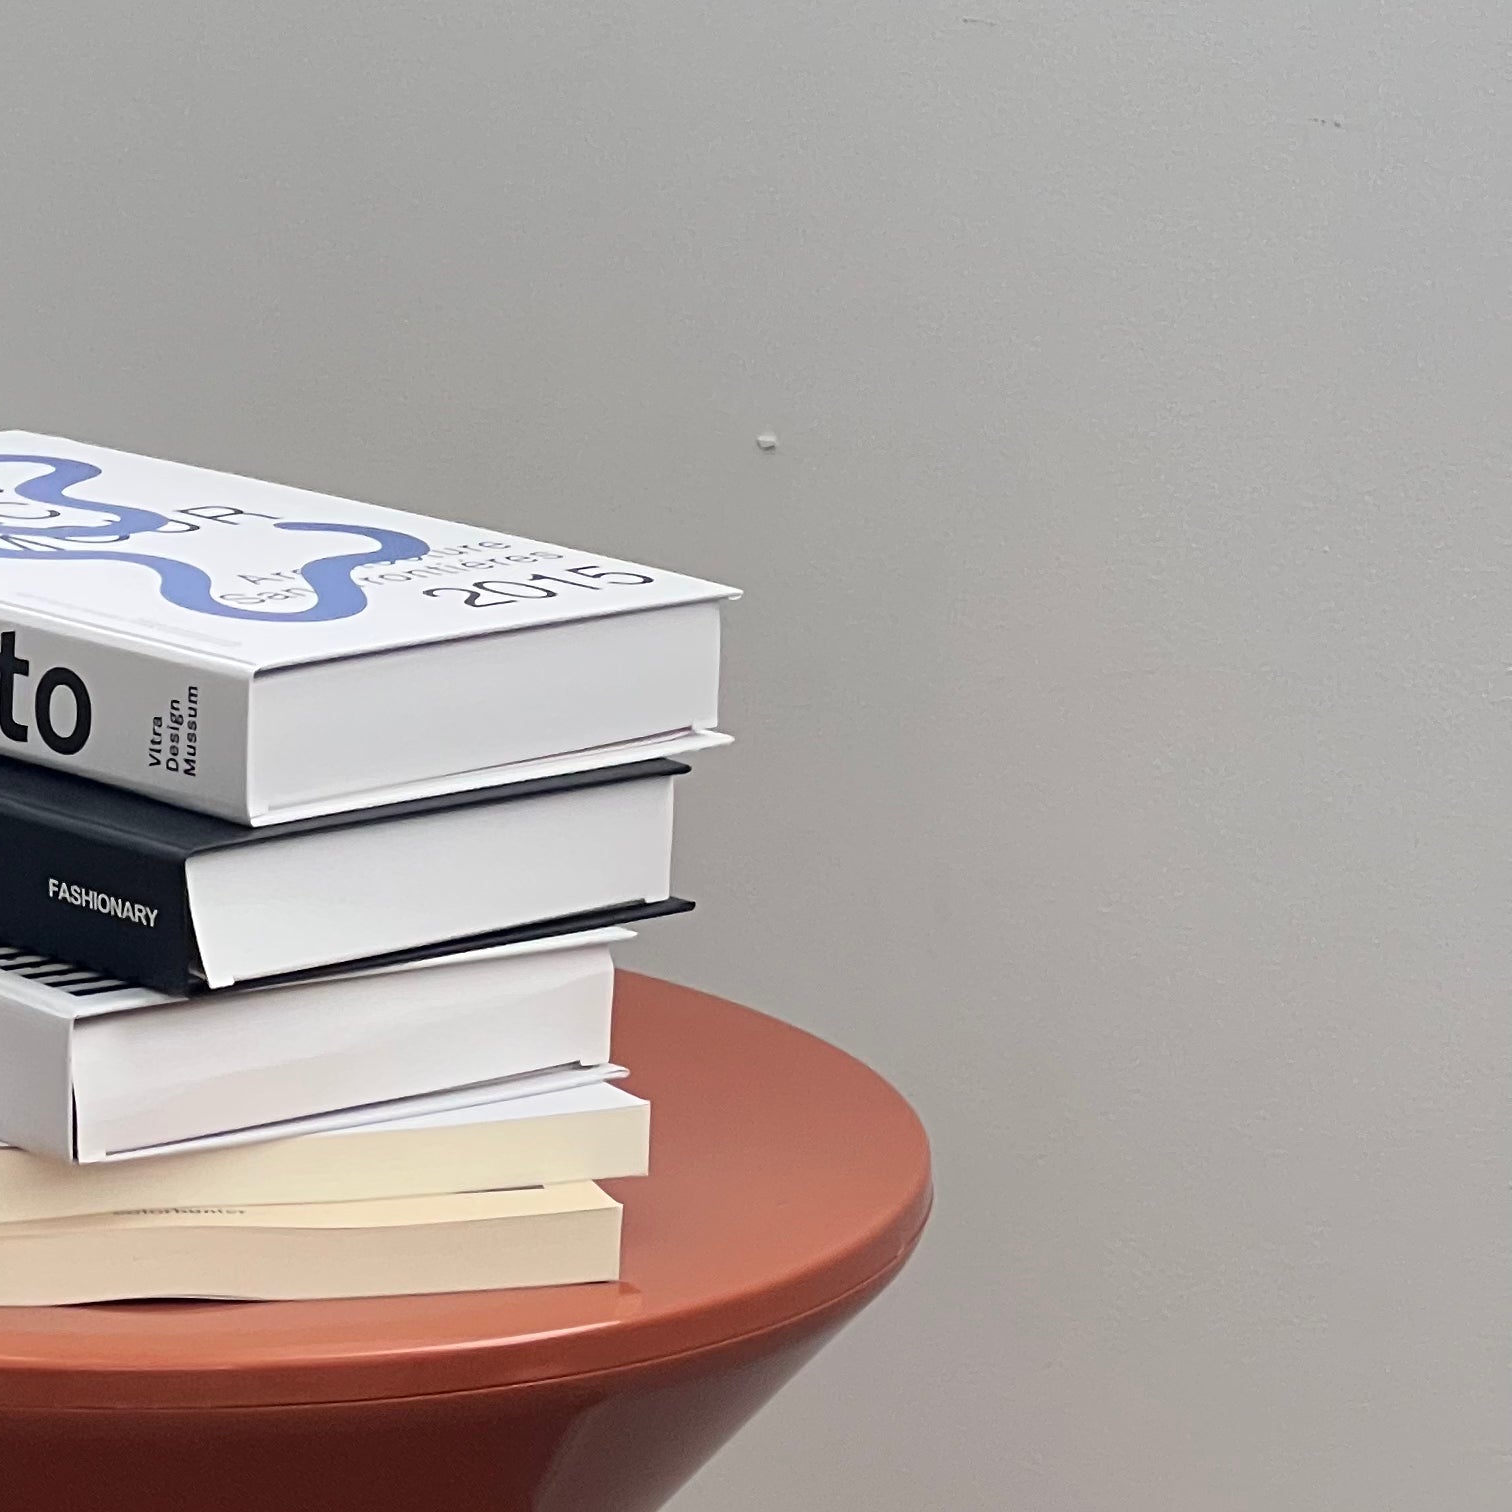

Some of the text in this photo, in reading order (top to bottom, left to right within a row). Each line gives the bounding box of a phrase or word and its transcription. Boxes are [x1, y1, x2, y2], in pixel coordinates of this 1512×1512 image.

[219, 586, 316, 606] San
[422, 565, 655, 608] 2015
[148, 716, 163, 767] Vitra
[166, 699, 184, 773] Design
[48, 878, 158, 928] FASHIONARY
